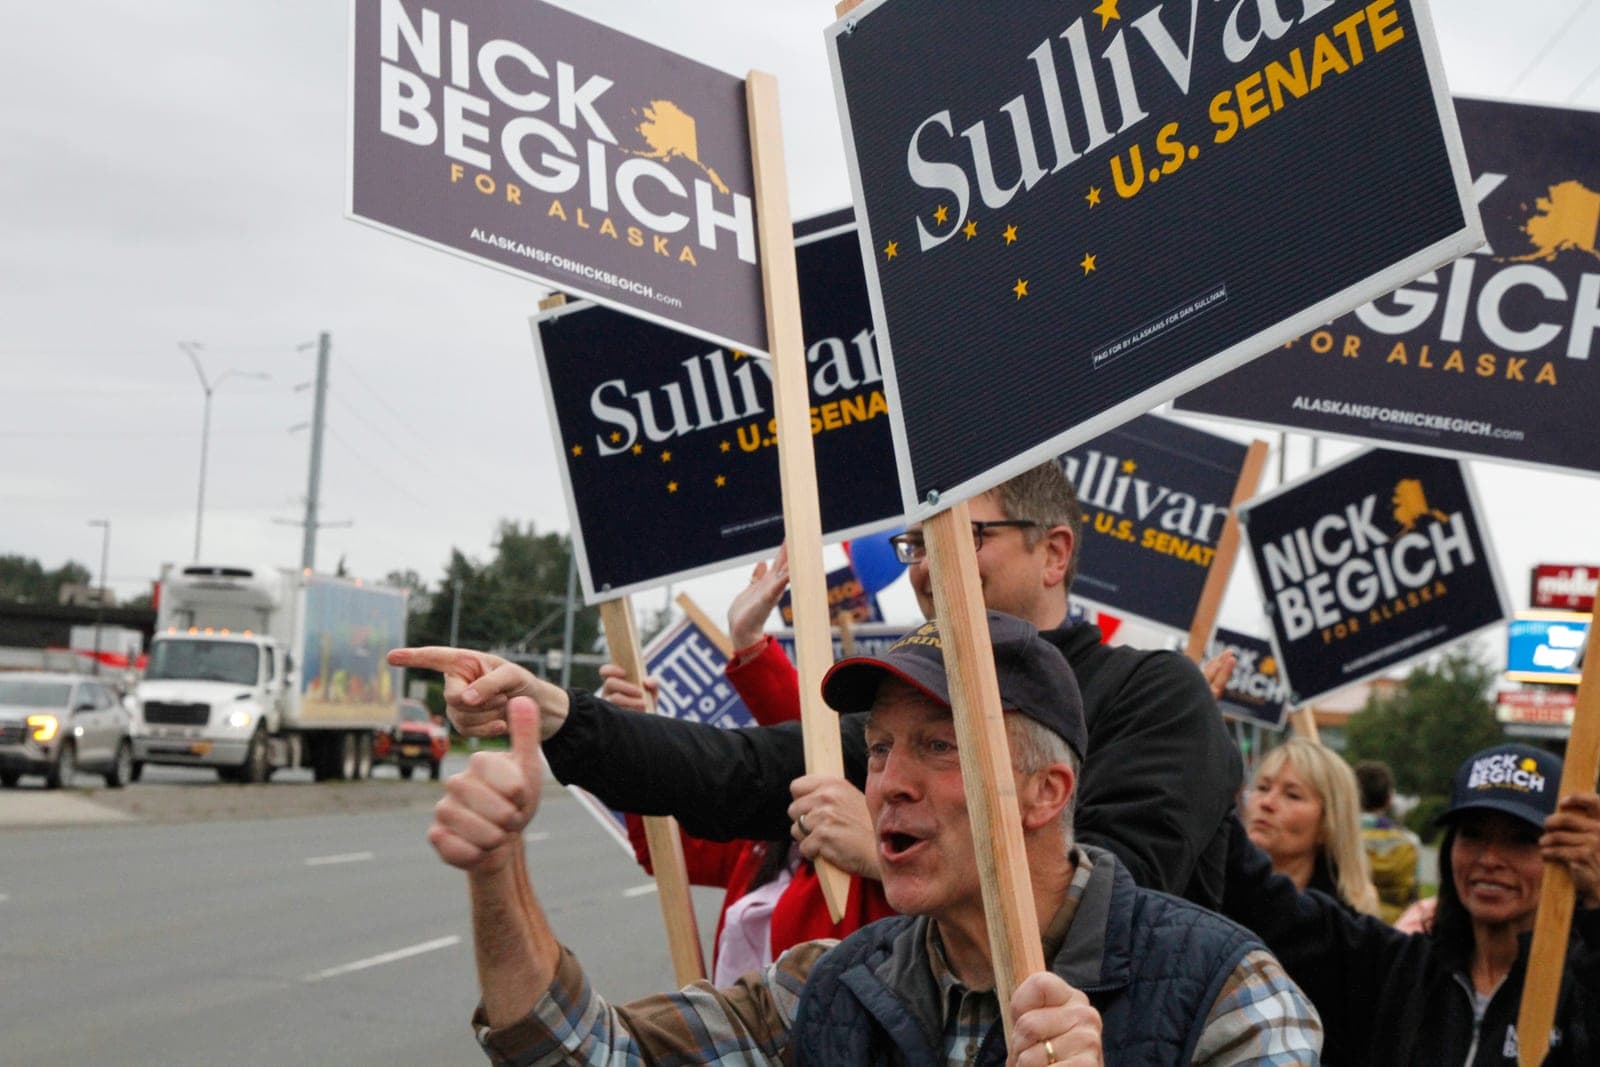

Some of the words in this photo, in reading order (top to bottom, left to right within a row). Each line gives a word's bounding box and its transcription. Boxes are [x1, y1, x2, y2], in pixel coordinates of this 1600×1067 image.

[380, 0, 619, 146] NICK
[1109, 121, 1200, 199] U.S.
[1207, 0, 1405, 144] SENATE
[380, 61, 757, 265] BEGICH
[906, 0, 1336, 253] Sulliva
[450, 162, 522, 206] FOR
[547, 199, 698, 267] ALASKA
[469, 227, 683, 309] ALASKANSFORNICKBEGICH.com
[1354, 256, 1600, 360] GIC
[1094, 351, 1108, 363] PAID
[1108, 343, 1122, 355] FOR
[1122, 338, 1132, 350] BY
[1131, 320, 1166, 344] ALASKANS
[1165, 313, 1180, 326] FOR
[1179, 306, 1194, 319] DAN
[1194, 289, 1226, 311] SULLIVAN
[1387, 341, 1558, 387] ALASKA
[809, 390, 888, 436] SENA
[1292, 395, 1525, 442] ALASKANSFORNICKBEGICH.com
[1093, 512, 1136, 543] U.S.
[1140, 527, 1218, 568] SENAT
[1261, 493, 1391, 591] NICK
[1275, 511, 1476, 641] BEGICH
[1321, 617, 1361, 646] FOR
[1368, 579, 1449, 625] ALASKA
[1466, 768, 1545, 793] BEGICH
